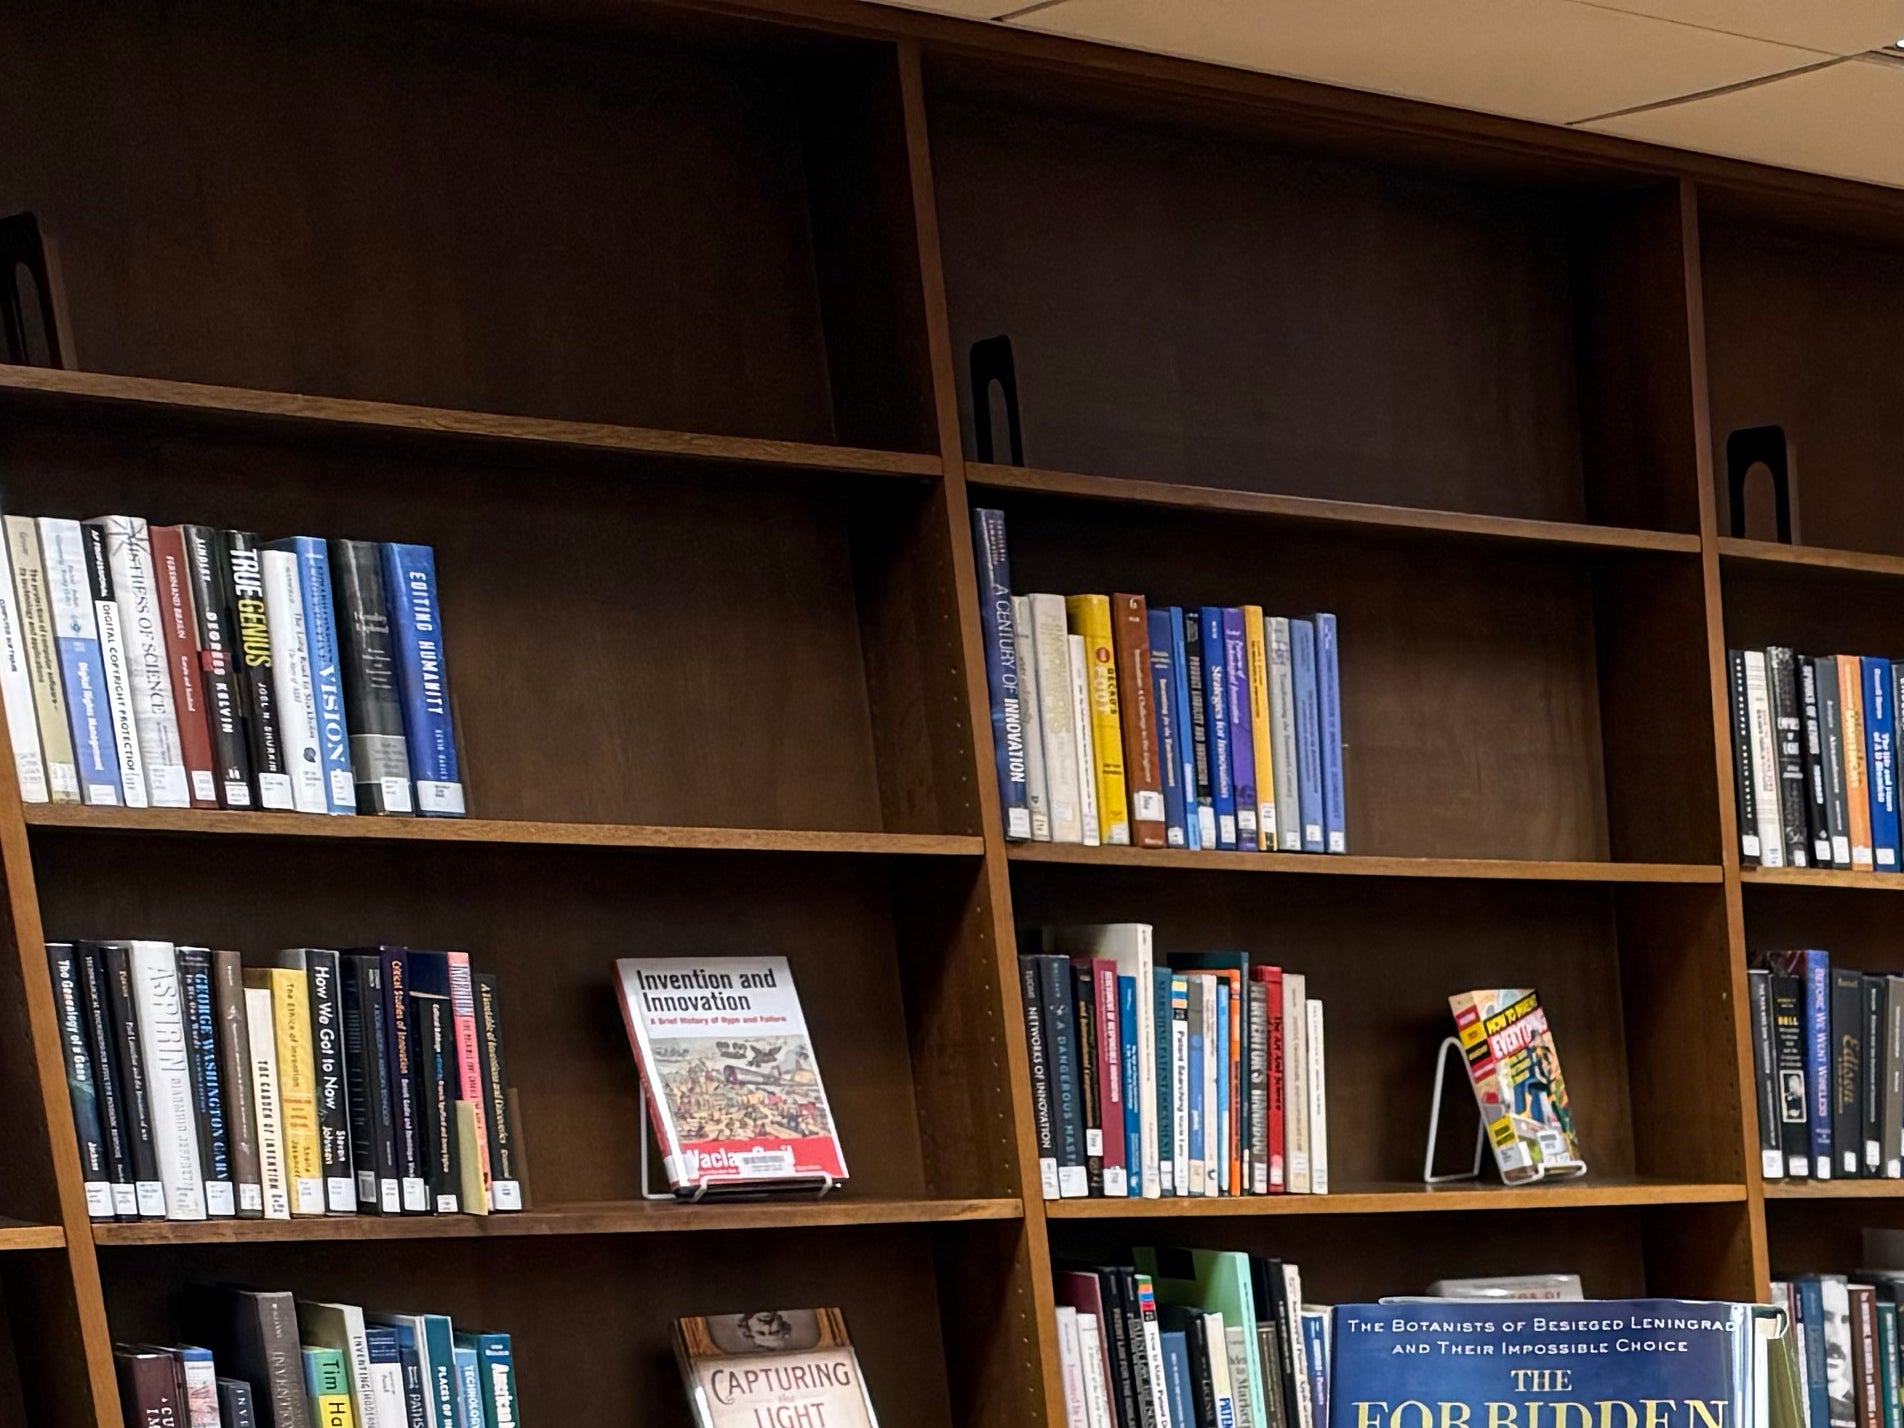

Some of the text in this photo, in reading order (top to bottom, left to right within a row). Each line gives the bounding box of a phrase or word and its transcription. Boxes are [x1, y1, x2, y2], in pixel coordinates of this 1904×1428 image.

[409, 570, 445, 716] EDITING HUMANITY
[995, 599, 1016, 671] CENTURY
[1004, 697, 1026, 784] INNOVATION
[637, 968, 777, 990] Invention and
[643, 991, 752, 1012] Innovation
[313, 965, 338, 1111] How We Got to Now
[1348, 1316, 1737, 1334] THE BOTANISTS OF BESIEGED LENINGRAD
[1392, 1338, 1688, 1356] AND THEIR IMPOSSIBLE CHOICE
[322, 1359, 341, 1393] Tim
[711, 1362, 851, 1405] CAPTURING
[1510, 1369, 1573, 1392] THE
